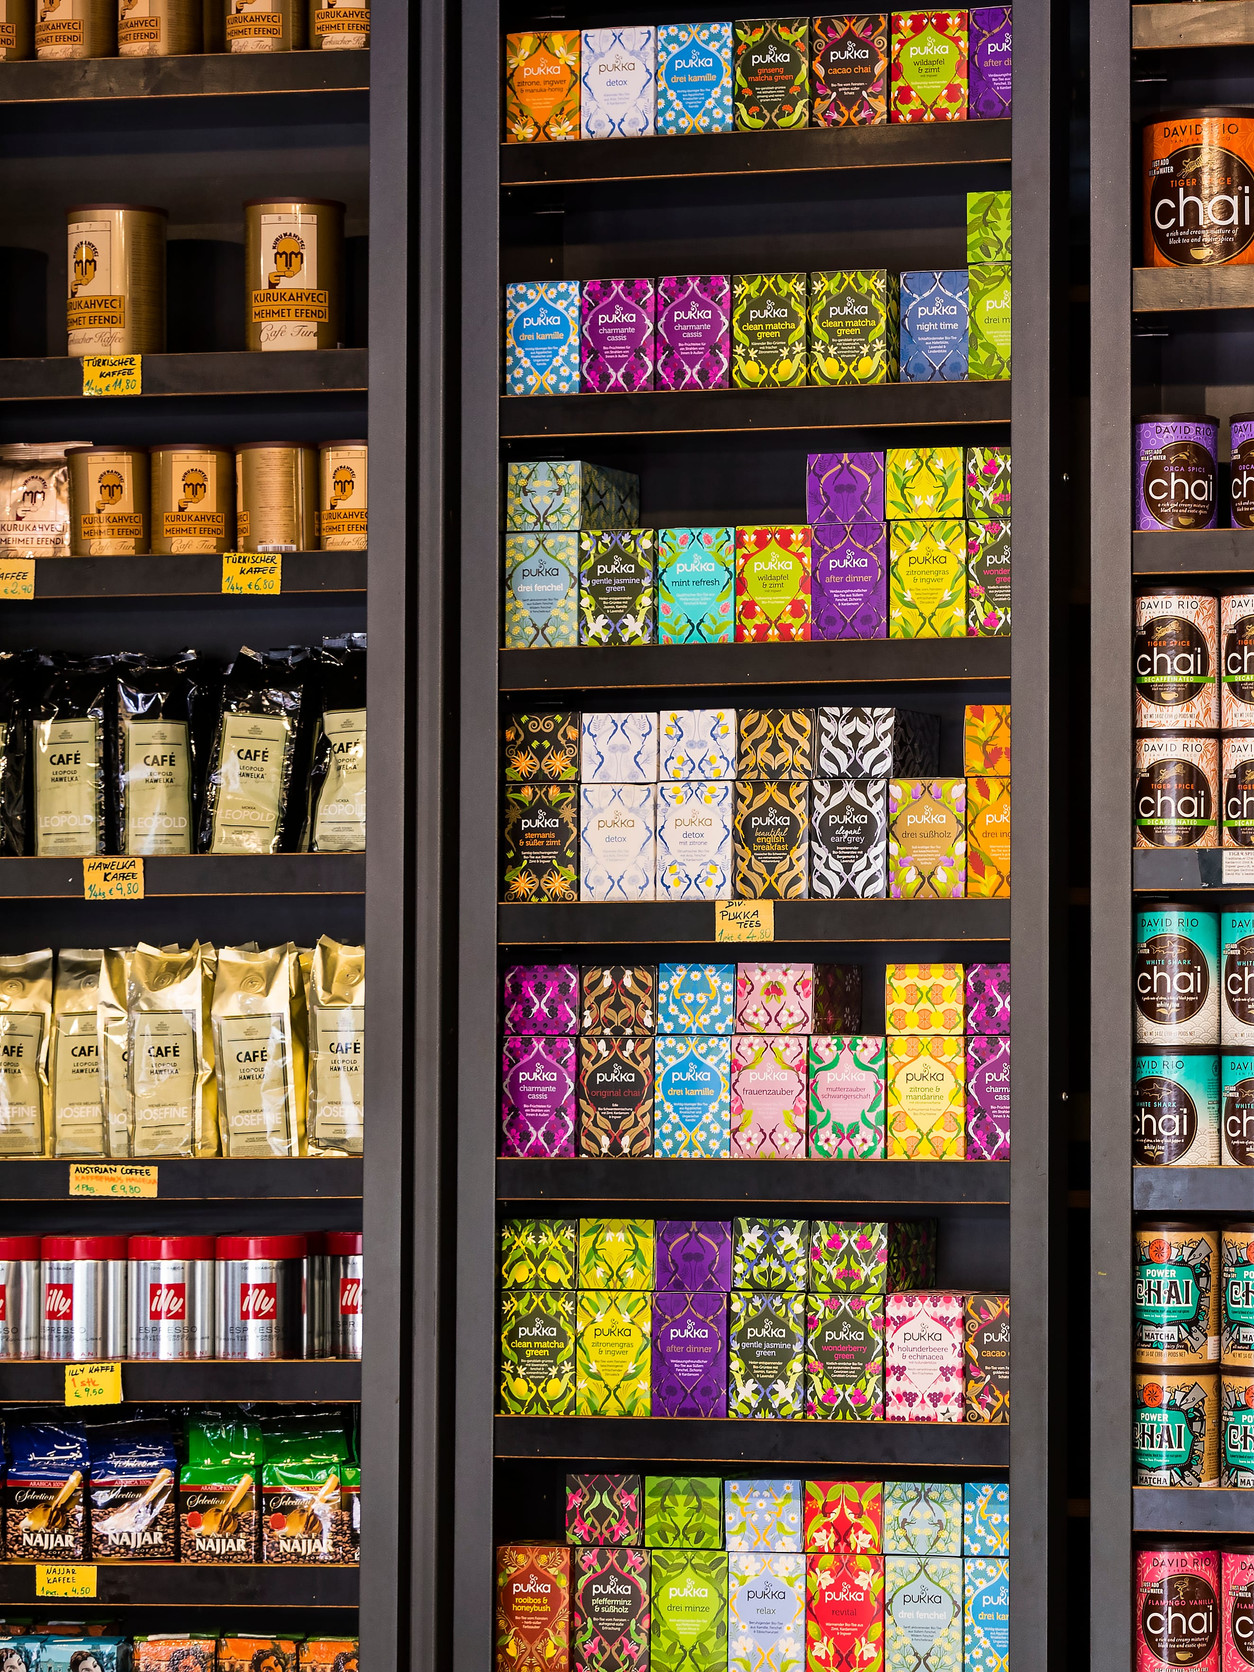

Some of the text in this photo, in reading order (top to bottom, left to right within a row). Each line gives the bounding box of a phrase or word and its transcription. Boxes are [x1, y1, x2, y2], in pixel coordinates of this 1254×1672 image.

[752, 48, 790, 65] pukka
[914, 59, 944, 67] wildapfel
[524, 59, 560, 78] pukka
[757, 67, 784, 75] ginseng
[828, 65, 871, 75] cacao chai
[688, 73, 716, 82] kamille
[1155, 185, 1250, 229] chai
[254, 308, 291, 319] MEHMET
[599, 327, 635, 335] charmante
[917, 321, 958, 332] night time
[1149, 471, 1213, 501] chai
[826, 573, 871, 582] after dinner
[906, 569, 949, 577] zitronengras
[592, 577, 639, 586] gentle jasmine
[672, 578, 719, 586] mint refresh
[1141, 599, 1198, 609] DAVID RIO
[1137, 648, 1201, 675] chai
[50, 752, 80, 765] CAFÉ
[39, 816, 93, 828] LEOPOLD
[919, 830, 951, 838] süßholz
[757, 835, 784, 844] english
[846, 835, 864, 843] grey
[753, 843, 788, 851] breakfast
[148, 1043, 179, 1058] CAFÉ
[591, 1087, 640, 1098] original chai
[742, 1087, 794, 1095] frauenzauber
[821, 1092, 870, 1100] schwangerschaft
[906, 1092, 943, 1100] mandarine
[138, 1106, 187, 1119] JOSEFINE
[151, 1290, 183, 1316] illy
[823, 1345, 867, 1354] wonderberry
[910, 1353, 944, 1361] echinacea
[15, 1490, 54, 1503] Selection
[23, 1534, 76, 1547] NAJJAR
[592, 1598, 631, 1608] pfefferminz
[512, 1604, 550, 1613] honeybush
[667, 1604, 709, 1612] drei minze
[832, 1608, 857, 1616] revital
